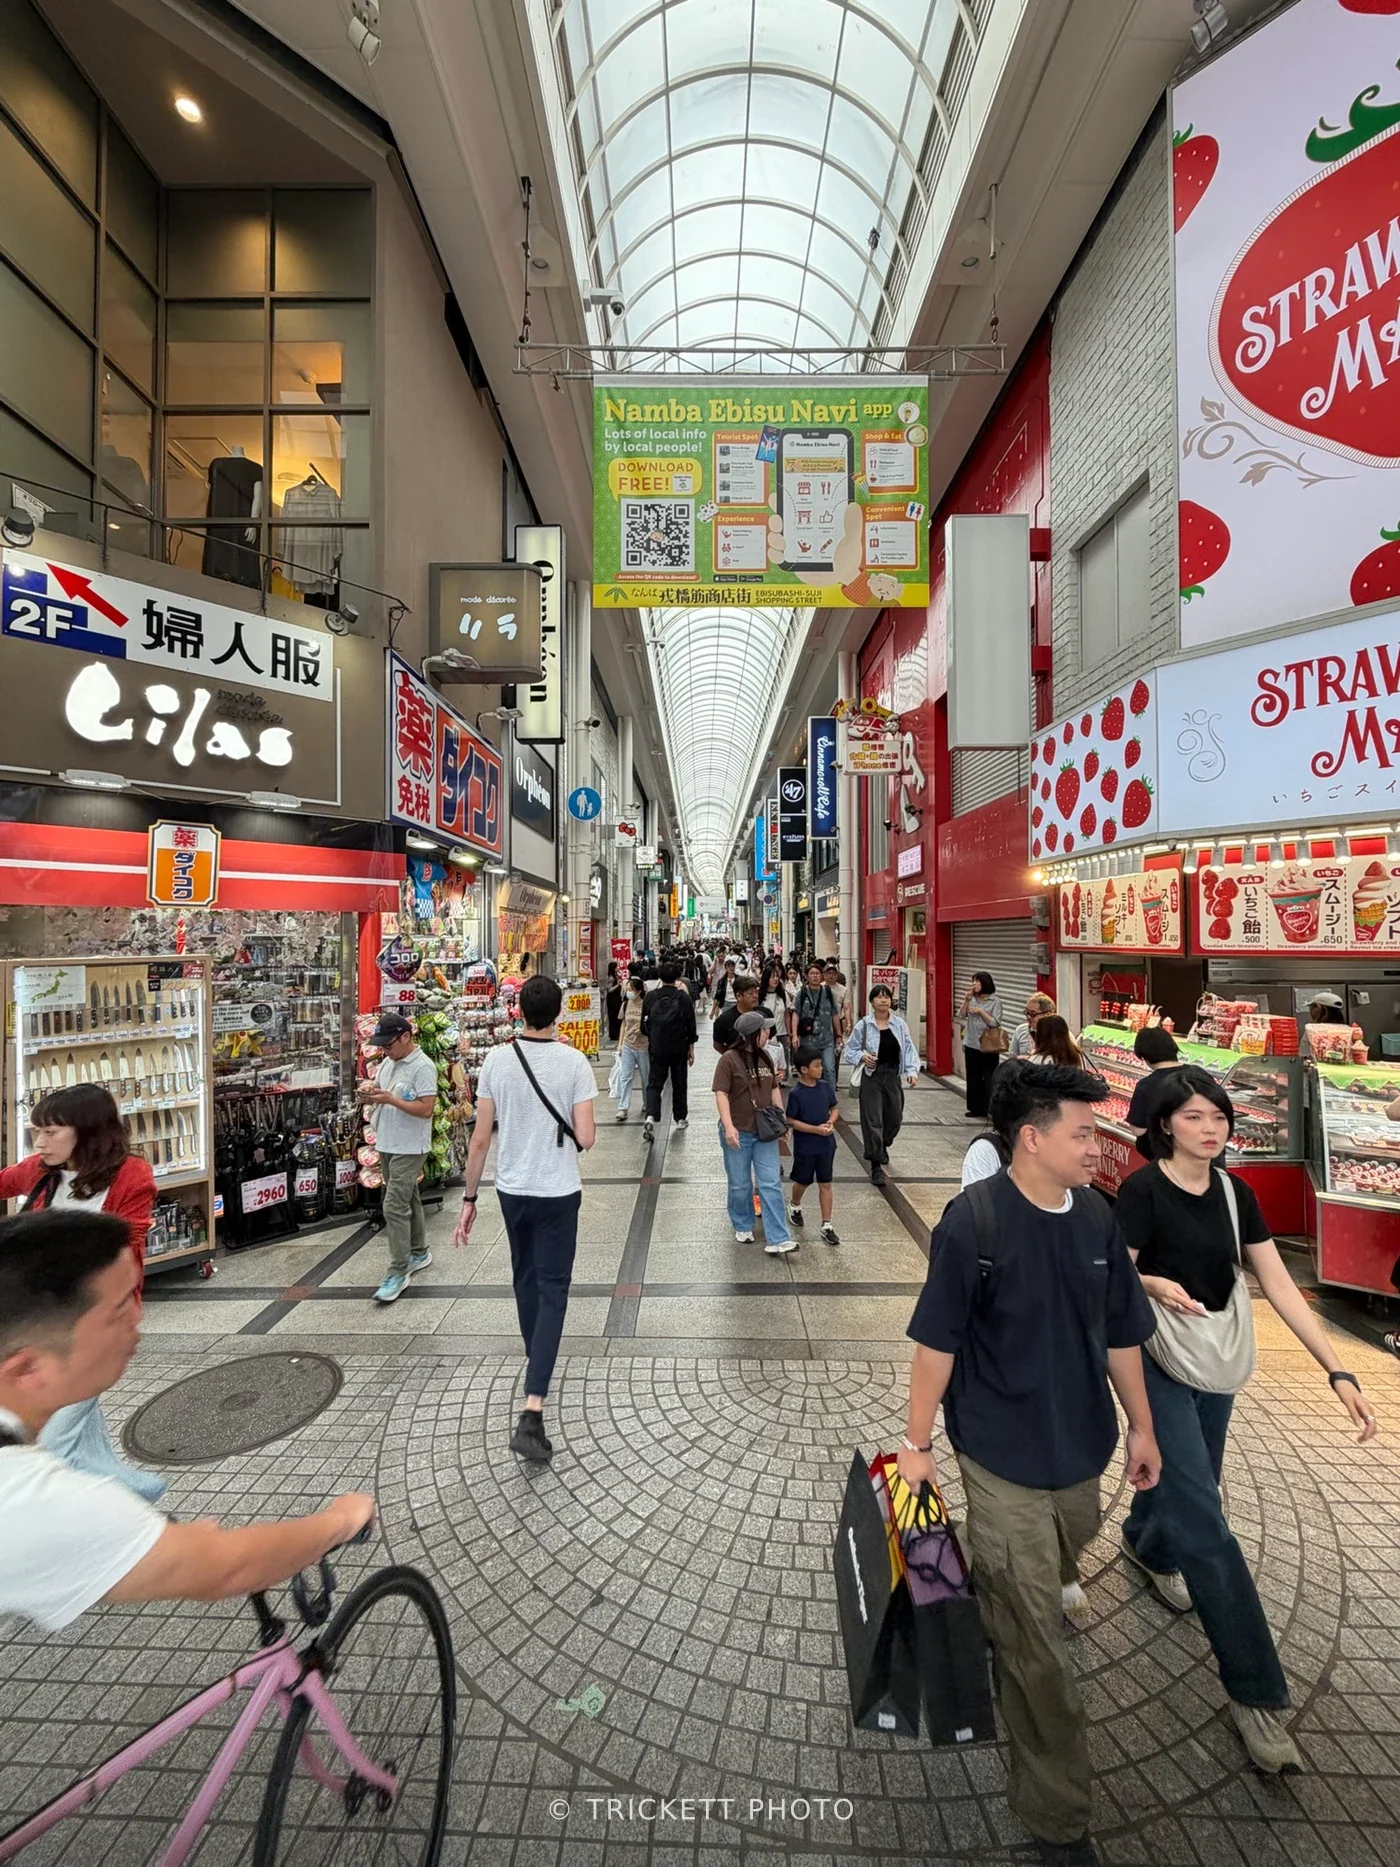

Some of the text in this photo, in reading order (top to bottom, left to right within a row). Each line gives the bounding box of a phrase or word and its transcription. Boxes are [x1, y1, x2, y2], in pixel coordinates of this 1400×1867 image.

[604, 398, 892, 422] Namba Ebisu Navi app
[604, 428, 707, 439] Lots of local info
[742, 433, 758, 441] Spot
[604, 442, 703, 454] by local people!
[618, 462, 694, 472] DOWNLOAD
[618, 477, 669, 491] FREE!
[717, 515, 754, 523] Experience
[865, 505, 905, 513] Convenient
[865, 513, 882, 521] Spot
[631, 587, 657, 597] なんば
[659, 587, 751, 604] 戎橋筋商店街
[9, 598, 73, 638] 2F
[459, 613, 517, 640] リラ
[141, 599, 321, 687] 婦人服
[394, 670, 434, 783] 薬
[441, 724, 499, 846] ダイコク
[397, 774, 431, 824] 免税
[172, 826, 199, 849] 薬
[171, 851, 198, 899] ダイコク
[1170, 886, 1178, 909] いちご
[1325, 879, 1341, 935] スムージー
[1114, 903, 1122, 938] ソフト
[1120, 892, 1128, 930] ミルキー
[1161, 888, 1169, 941] スムージー
[1242, 886, 1262, 935] いちご飴
[398, 989, 415, 1001] 88
[557, 1020, 598, 1031] SALE!
[257, 1184, 285, 1205] 2960
[299, 1179, 316, 1192] 650
